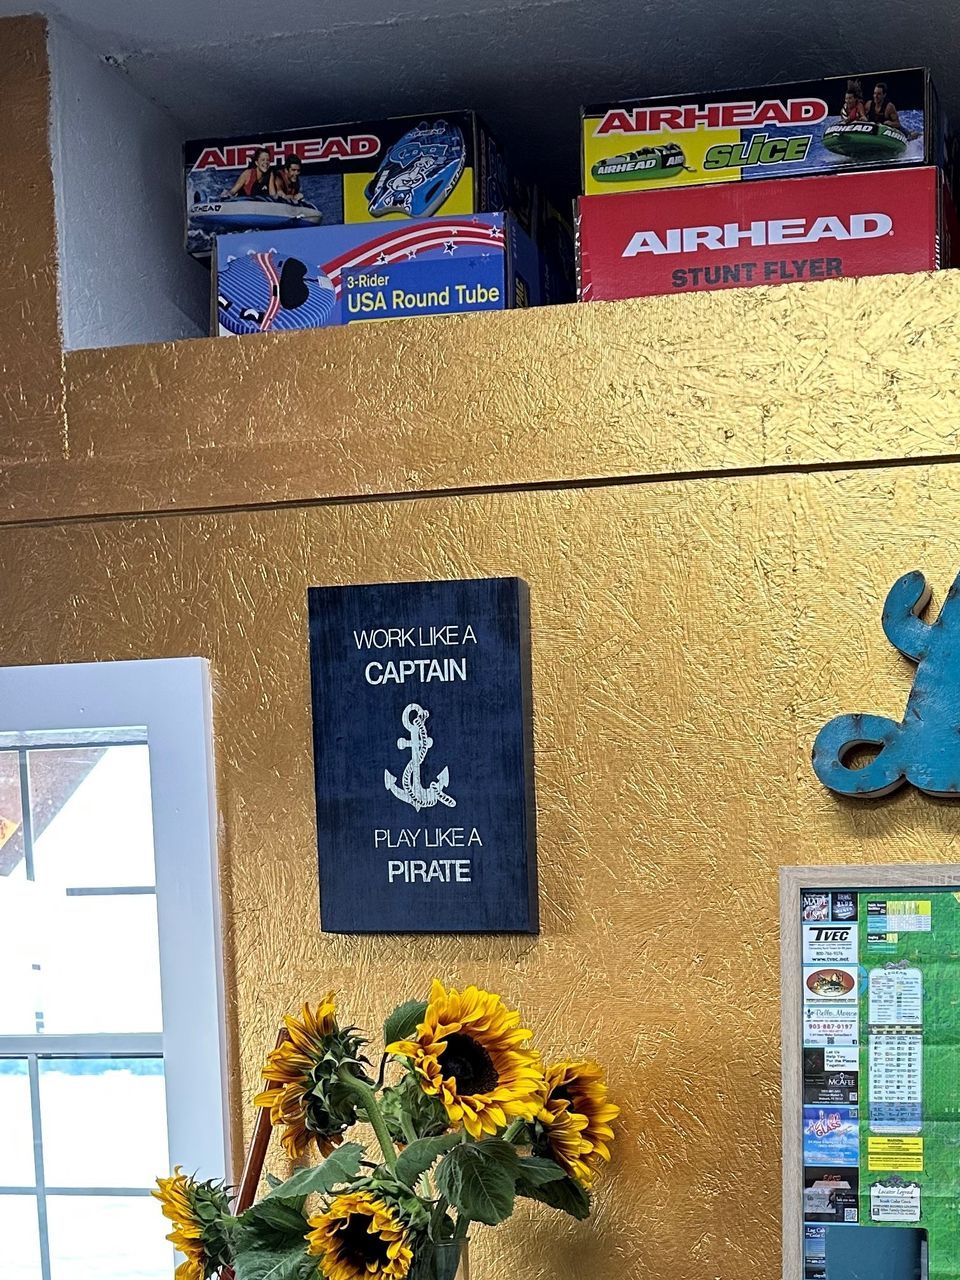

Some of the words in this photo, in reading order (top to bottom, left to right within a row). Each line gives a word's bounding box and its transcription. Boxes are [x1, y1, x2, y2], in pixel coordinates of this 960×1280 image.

[593, 98, 828, 137] AIRHEAD
[191, 135, 381, 172] AIRHEAD
[598, 159, 656, 174] AIRHEAD
[621, 213, 893, 257] AIRHEAD
[347, 274, 389, 288] 3-Rider
[672, 261, 757, 288] STUNT
[764, 257, 843, 281] FLYER
[347, 292, 387, 313] USA
[392, 287, 450, 309] Round
[454, 283, 500, 303] Tube
[354, 627, 415, 649] WORK
[419, 625, 459, 646] LIKE
[462, 625, 477, 644] A
[365, 658, 467, 685] CAPTAIN
[375, 829, 420, 848] PLAY
[424, 828, 465, 847] LIKE
[467, 828, 482, 846] A
[388, 860, 472, 883] PIRATE
[809, 927, 852, 941] TVEC
